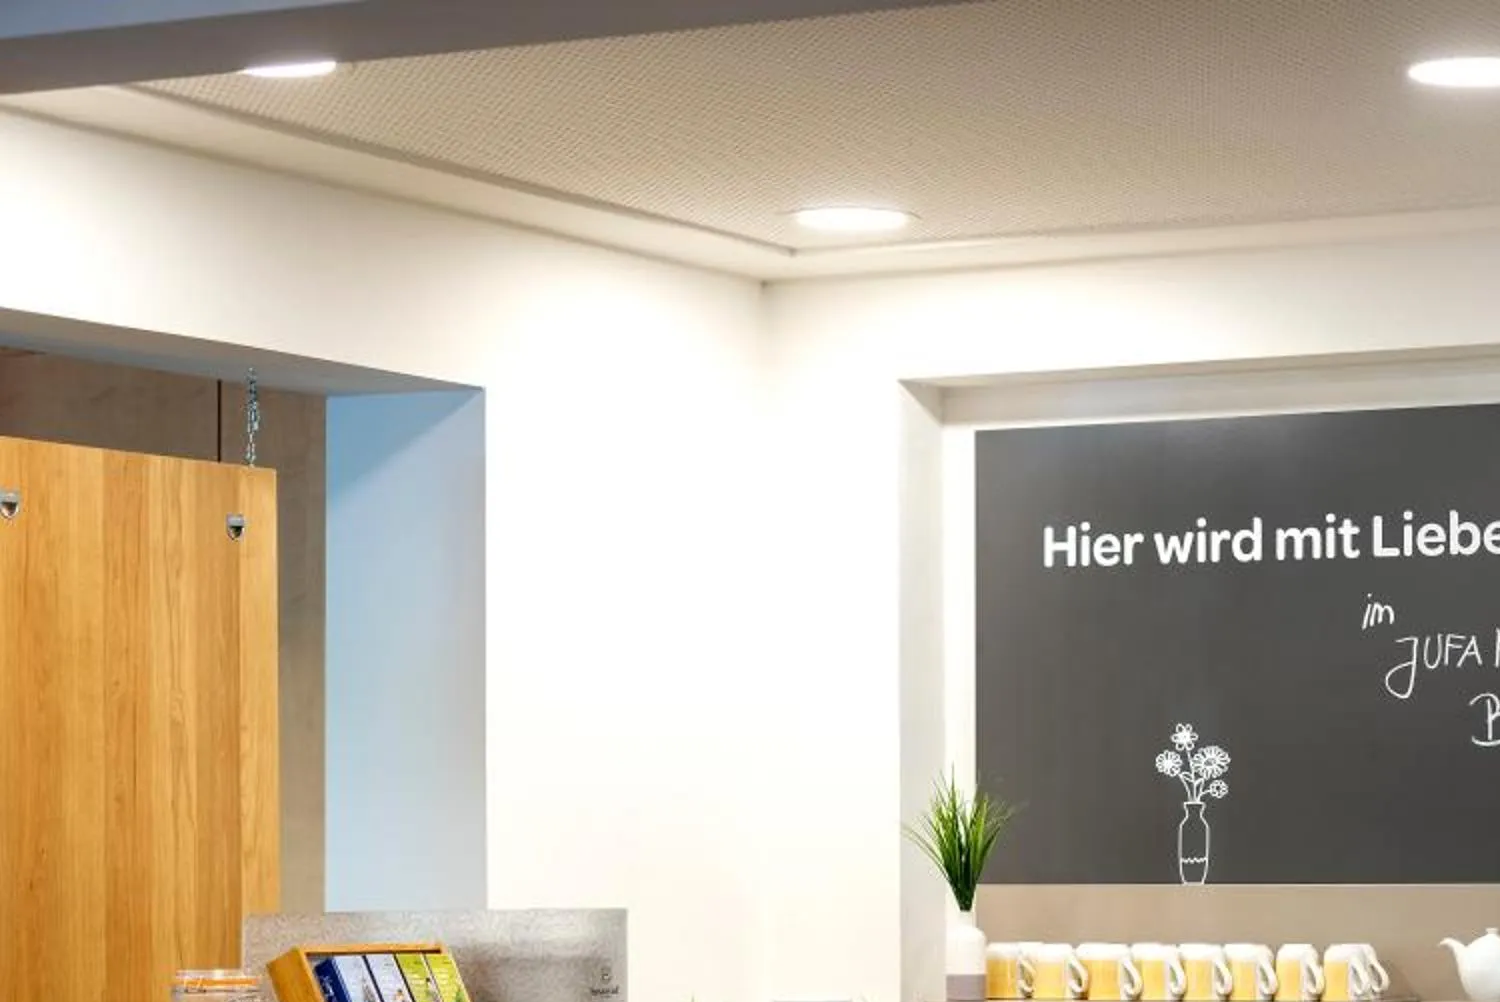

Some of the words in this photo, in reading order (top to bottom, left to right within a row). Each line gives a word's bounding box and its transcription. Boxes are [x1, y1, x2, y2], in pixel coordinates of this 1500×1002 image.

[1043, 521, 1145, 569] Hier
[1153, 516, 1263, 565] wird
[1275, 512, 1361, 561] mit
[1361, 592, 1396, 631] im
[1384, 635, 1483, 699] JUFA
